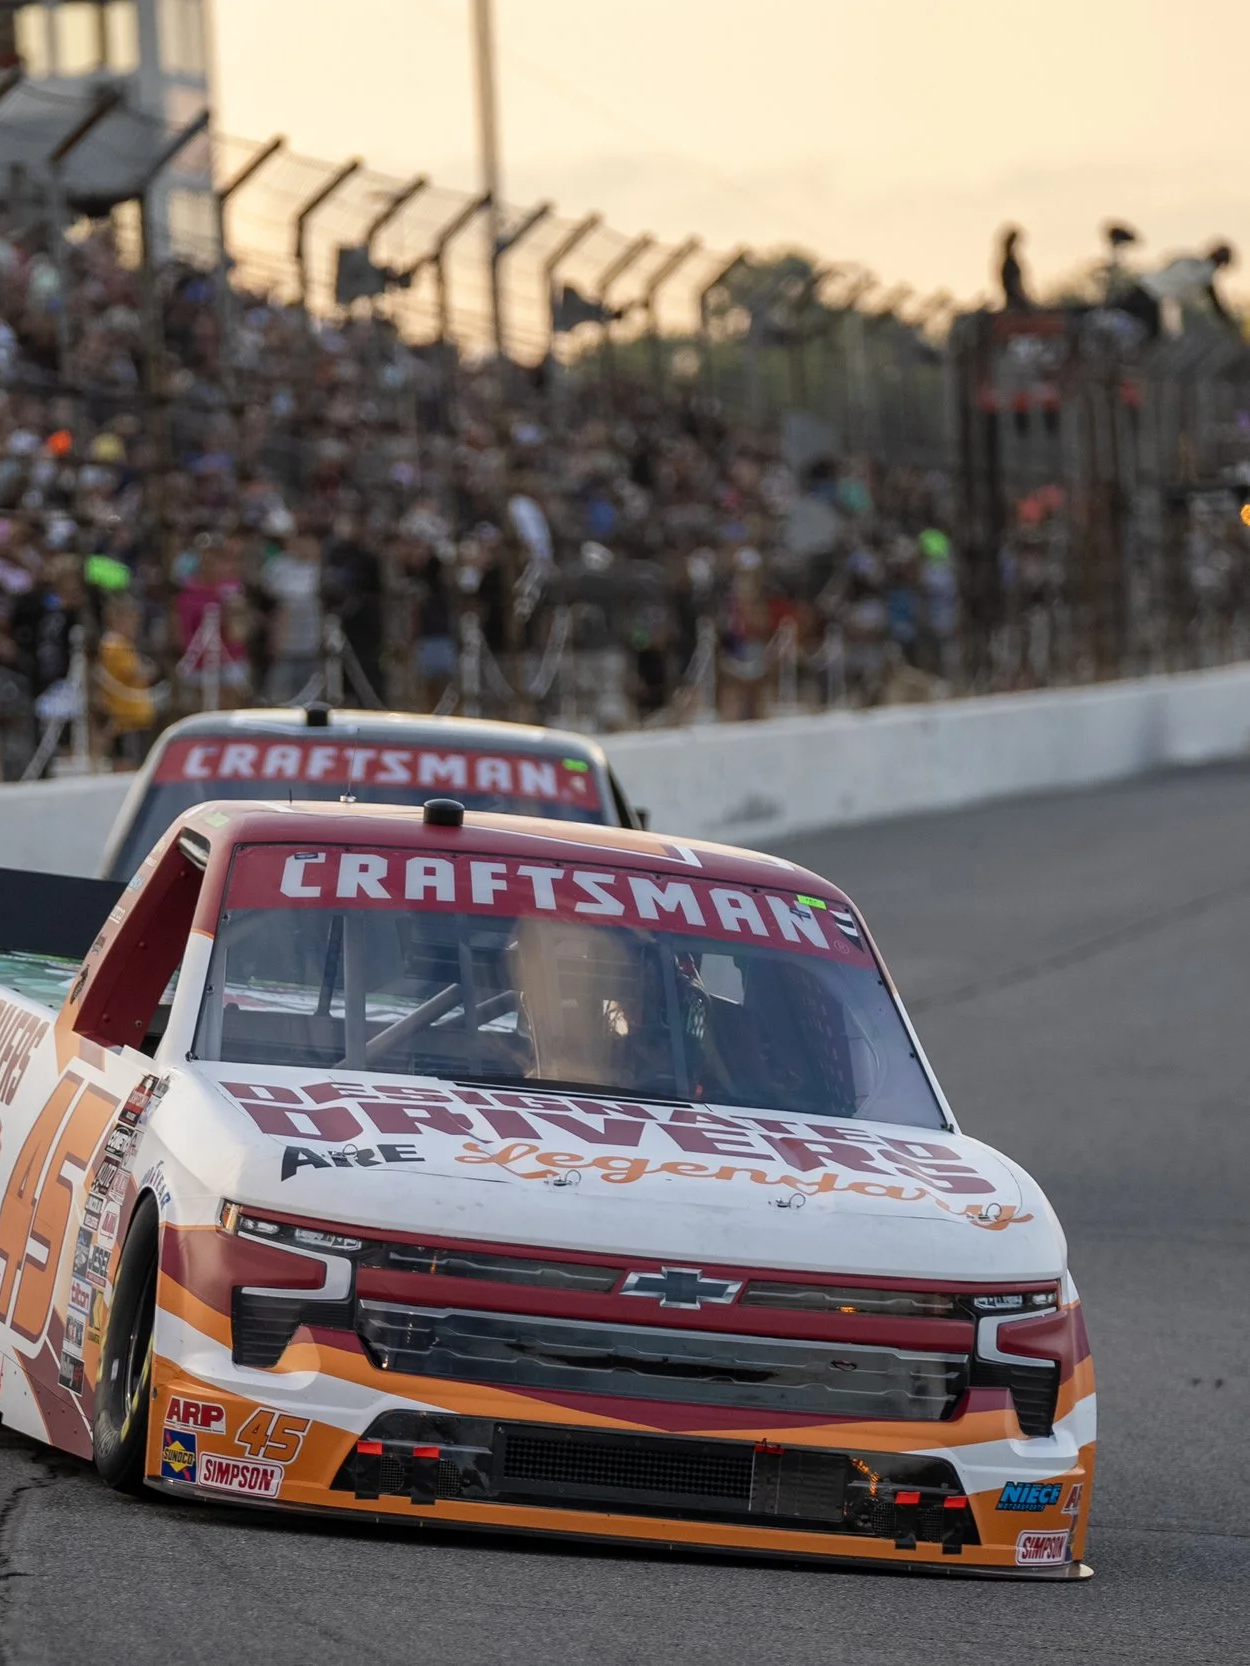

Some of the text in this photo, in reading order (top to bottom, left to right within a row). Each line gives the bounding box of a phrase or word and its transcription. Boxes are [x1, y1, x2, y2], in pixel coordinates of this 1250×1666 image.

[184, 743, 557, 797] CRAFTSMAN
[279, 852, 831, 950] CRAFTSMAN
[218, 1081, 961, 1160] DESIGNATED
[240, 1102, 996, 1194] DRIVERS
[281, 1143, 425, 1182] ARE
[166, 1398, 224, 1428] ARP
[237, 1408, 311, 1463] 45
[163, 1448, 194, 1466] SUNOCO
[203, 1458, 275, 1492] SIMPSON
[1000, 1482, 1062, 1504] NIECE
[1021, 1536, 1066, 1559] SIMPSON
